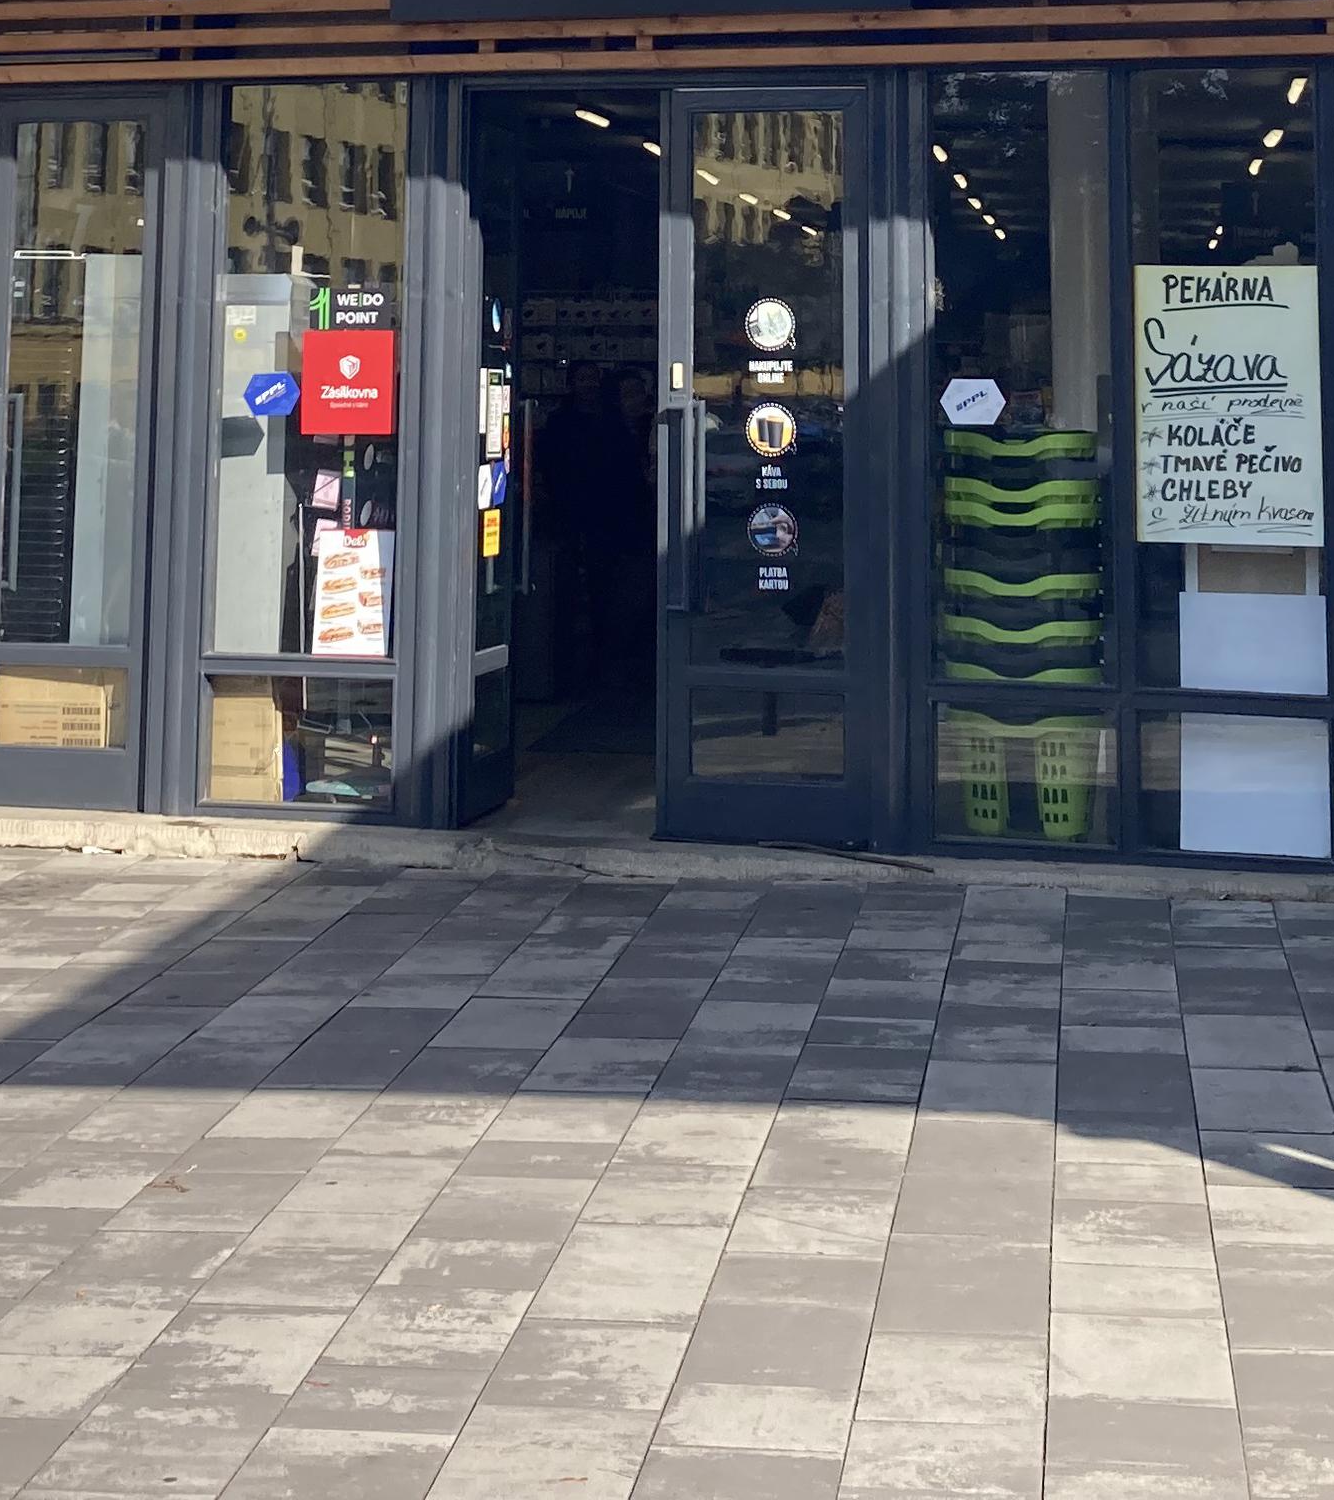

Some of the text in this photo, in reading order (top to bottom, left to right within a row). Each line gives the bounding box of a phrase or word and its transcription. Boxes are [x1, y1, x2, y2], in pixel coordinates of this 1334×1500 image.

[1162, 271, 1274, 304] PEKÁRNA
[335, 312, 379, 325] POINT
[1143, 317, 1288, 386] Sázava
[1167, 417, 1256, 447] KOLÁČE
[1159, 445, 1303, 475] TMAVÉ PEČIVO
[761, 463, 782, 477] KÁVA
[755, 478, 788, 489] S SEBOU
[1161, 478, 1253, 502] CHLEBY
[759, 566, 788, 578] PLATBA
[758, 579, 789, 590] KARTOU
